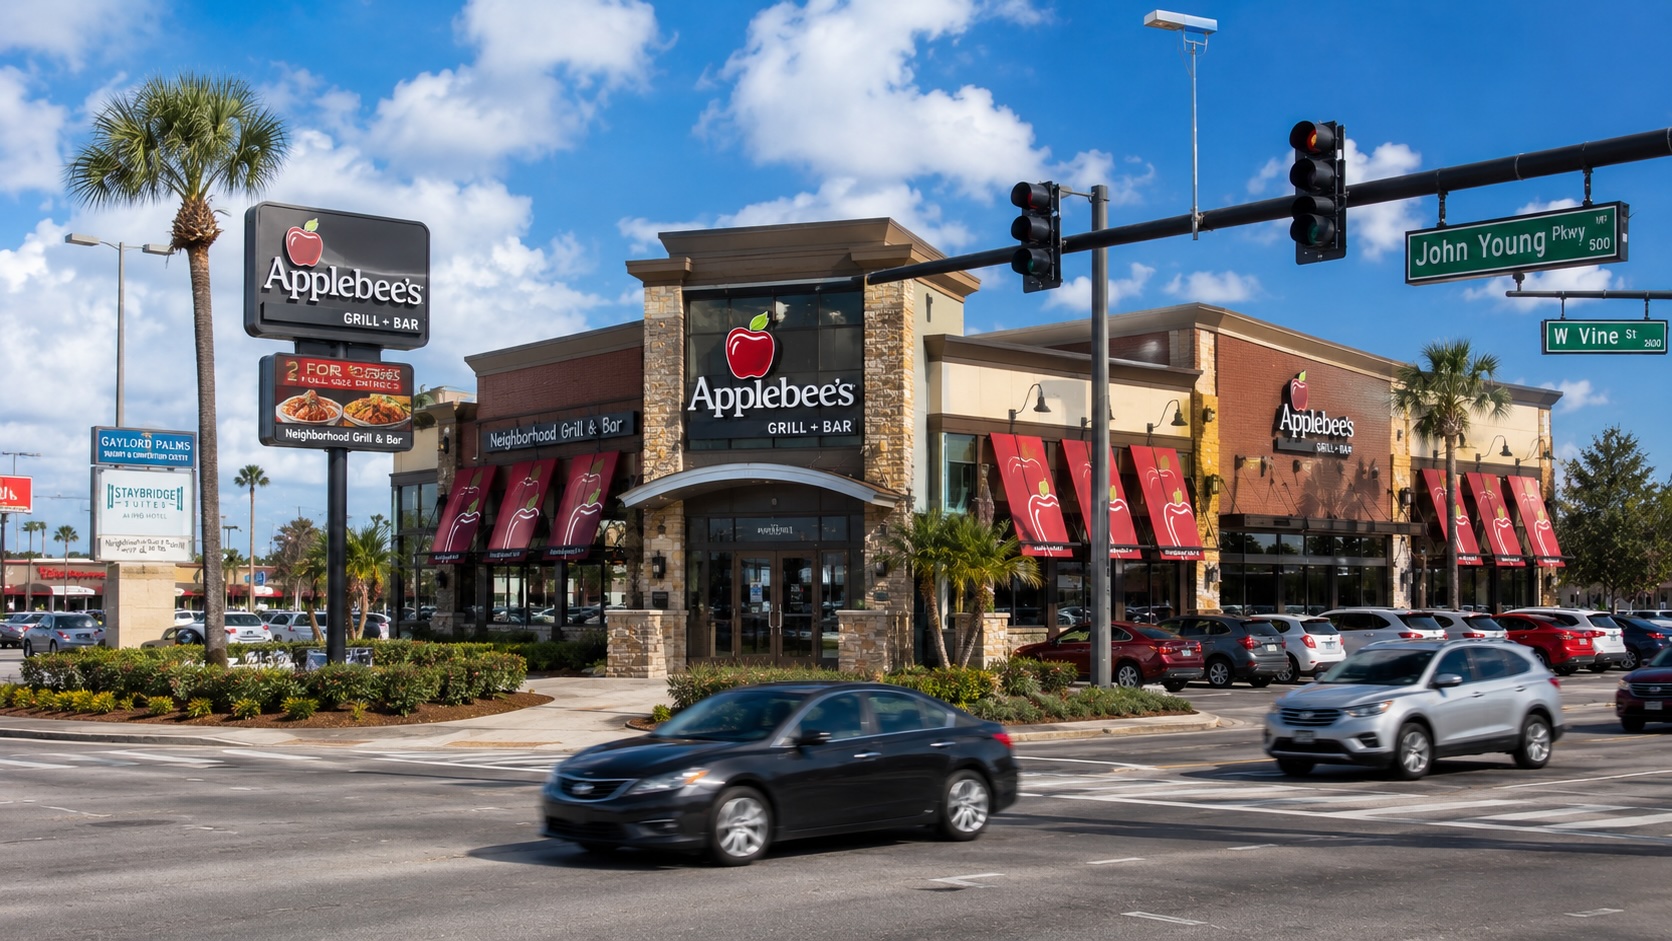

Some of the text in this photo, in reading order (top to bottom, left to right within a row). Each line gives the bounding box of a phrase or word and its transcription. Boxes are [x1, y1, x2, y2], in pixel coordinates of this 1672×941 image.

[1415, 224, 1586, 266] John Young Pkwy
[1589, 237, 1610, 251] 500
[263, 256, 422, 305] Applebee's
[343, 312, 379, 327] GRILL
[393, 317, 419, 330] BAR
[1554, 327, 1637, 345] W Vine St
[286, 361, 299, 381] 2
[306, 363, 342, 376] FOR
[687, 376, 855, 417] Applebee's
[767, 421, 807, 434] GRILL
[823, 420, 852, 432] BAR
[1279, 403, 1354, 438] Applebee's
[285, 428, 403, 445] Neighborhood Grill & Bar
[490, 417, 623, 451] Neighborhood Grill & Bar
[101, 436, 191, 451] GAYLORD PALMS
[115, 486, 176, 500] STAYBRIDGE
